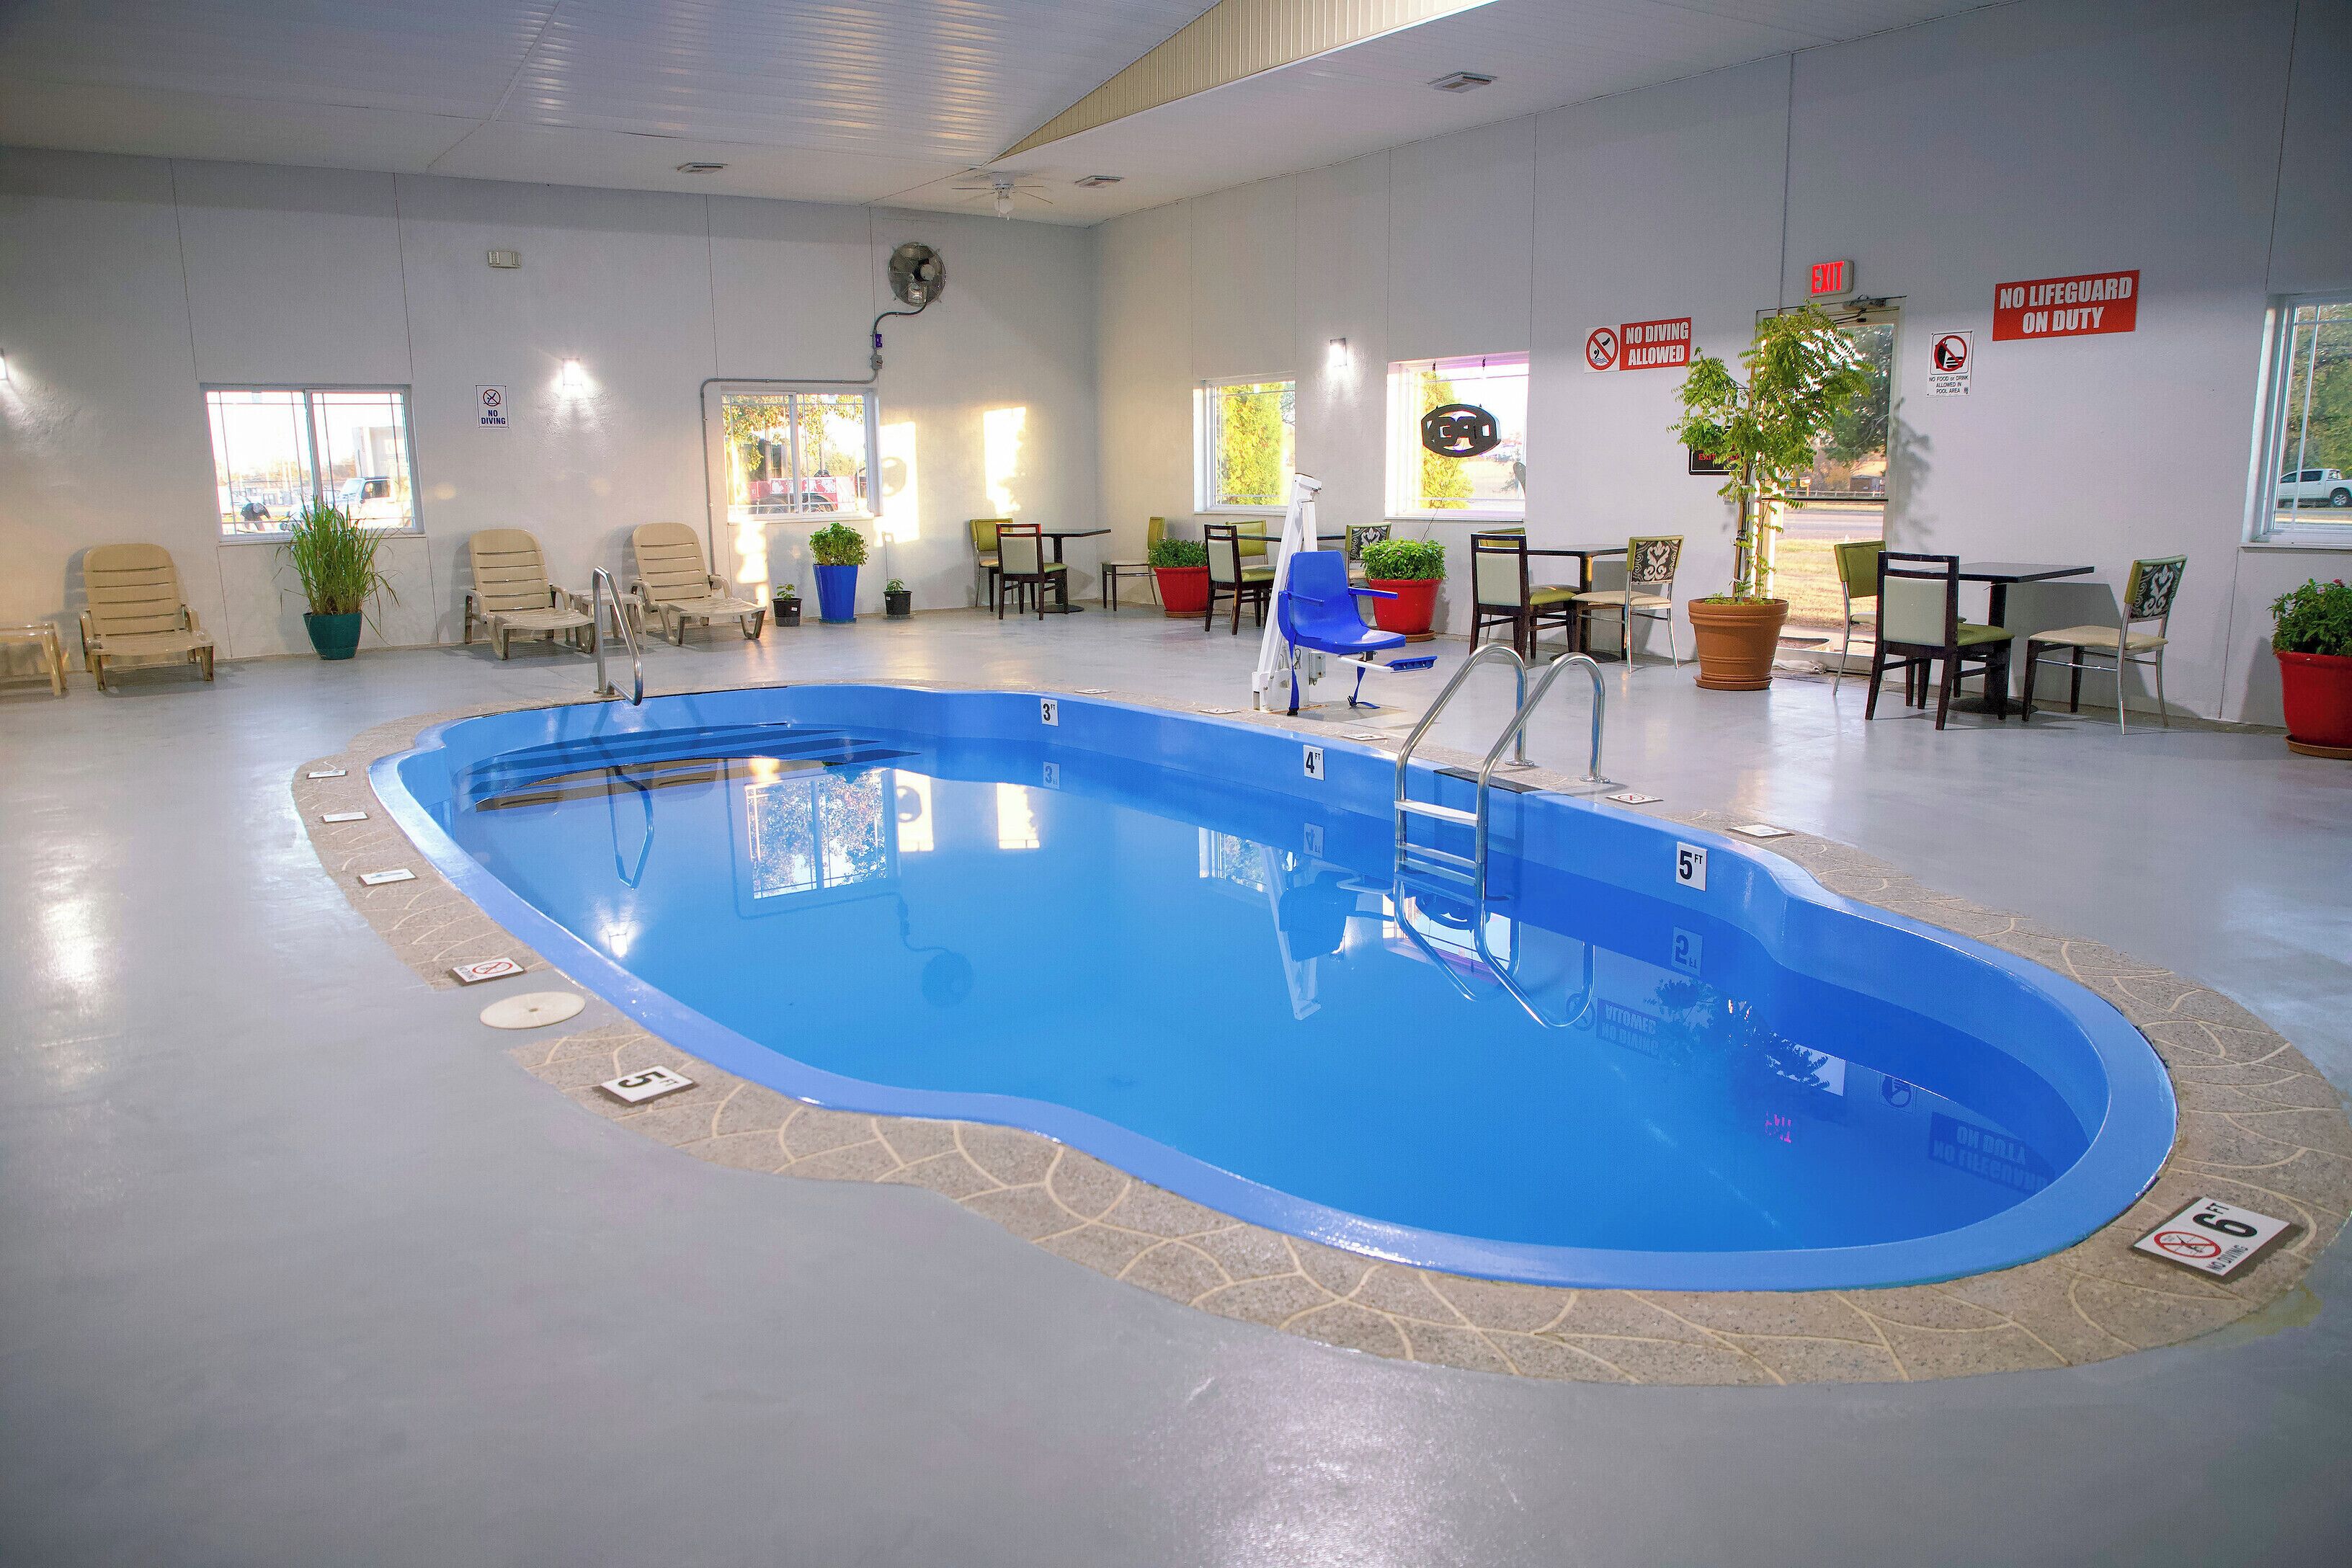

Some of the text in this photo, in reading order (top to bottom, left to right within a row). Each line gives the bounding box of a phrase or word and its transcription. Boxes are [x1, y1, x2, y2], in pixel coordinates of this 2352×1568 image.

[1812, 261, 1845, 294] EXIT
[2000, 277, 2133, 309] NO LIFEGUARD
[1626, 321, 1689, 344] NO DIVING
[2022, 307, 2104, 334] ON DUTY
[1628, 344, 1684, 365] ALLOWED
[1043, 703, 1051, 721] 3
[1306, 751, 1315, 773] 4
[1679, 850, 1703, 880] 5 FT
[618, 1071, 667, 1087] 5
[2193, 1213, 2257, 1238] 6
